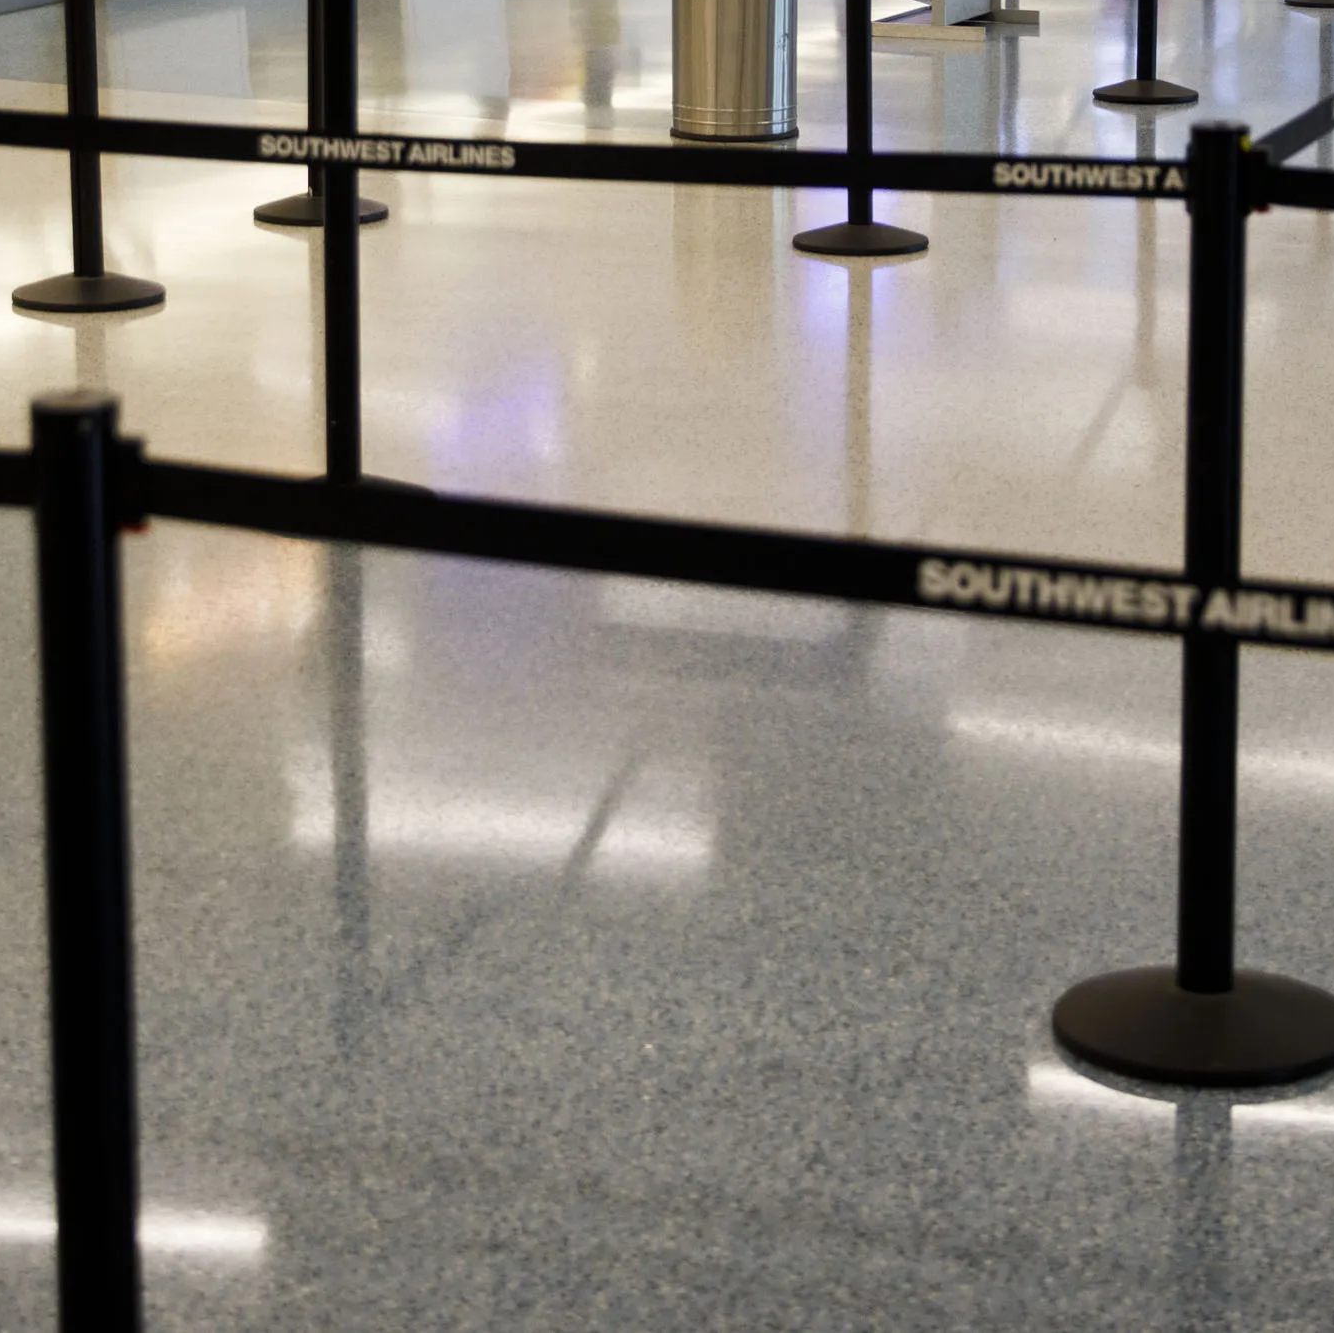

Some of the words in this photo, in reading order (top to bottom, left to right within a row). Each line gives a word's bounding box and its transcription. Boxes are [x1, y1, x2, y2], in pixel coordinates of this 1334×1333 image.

[259, 133, 406, 164] SOUTHWEST
[408, 142, 517, 168] AIRLINES
[993, 161, 1160, 190] SOUTHWEST
[915, 558, 1198, 626] SOUTHWEST
